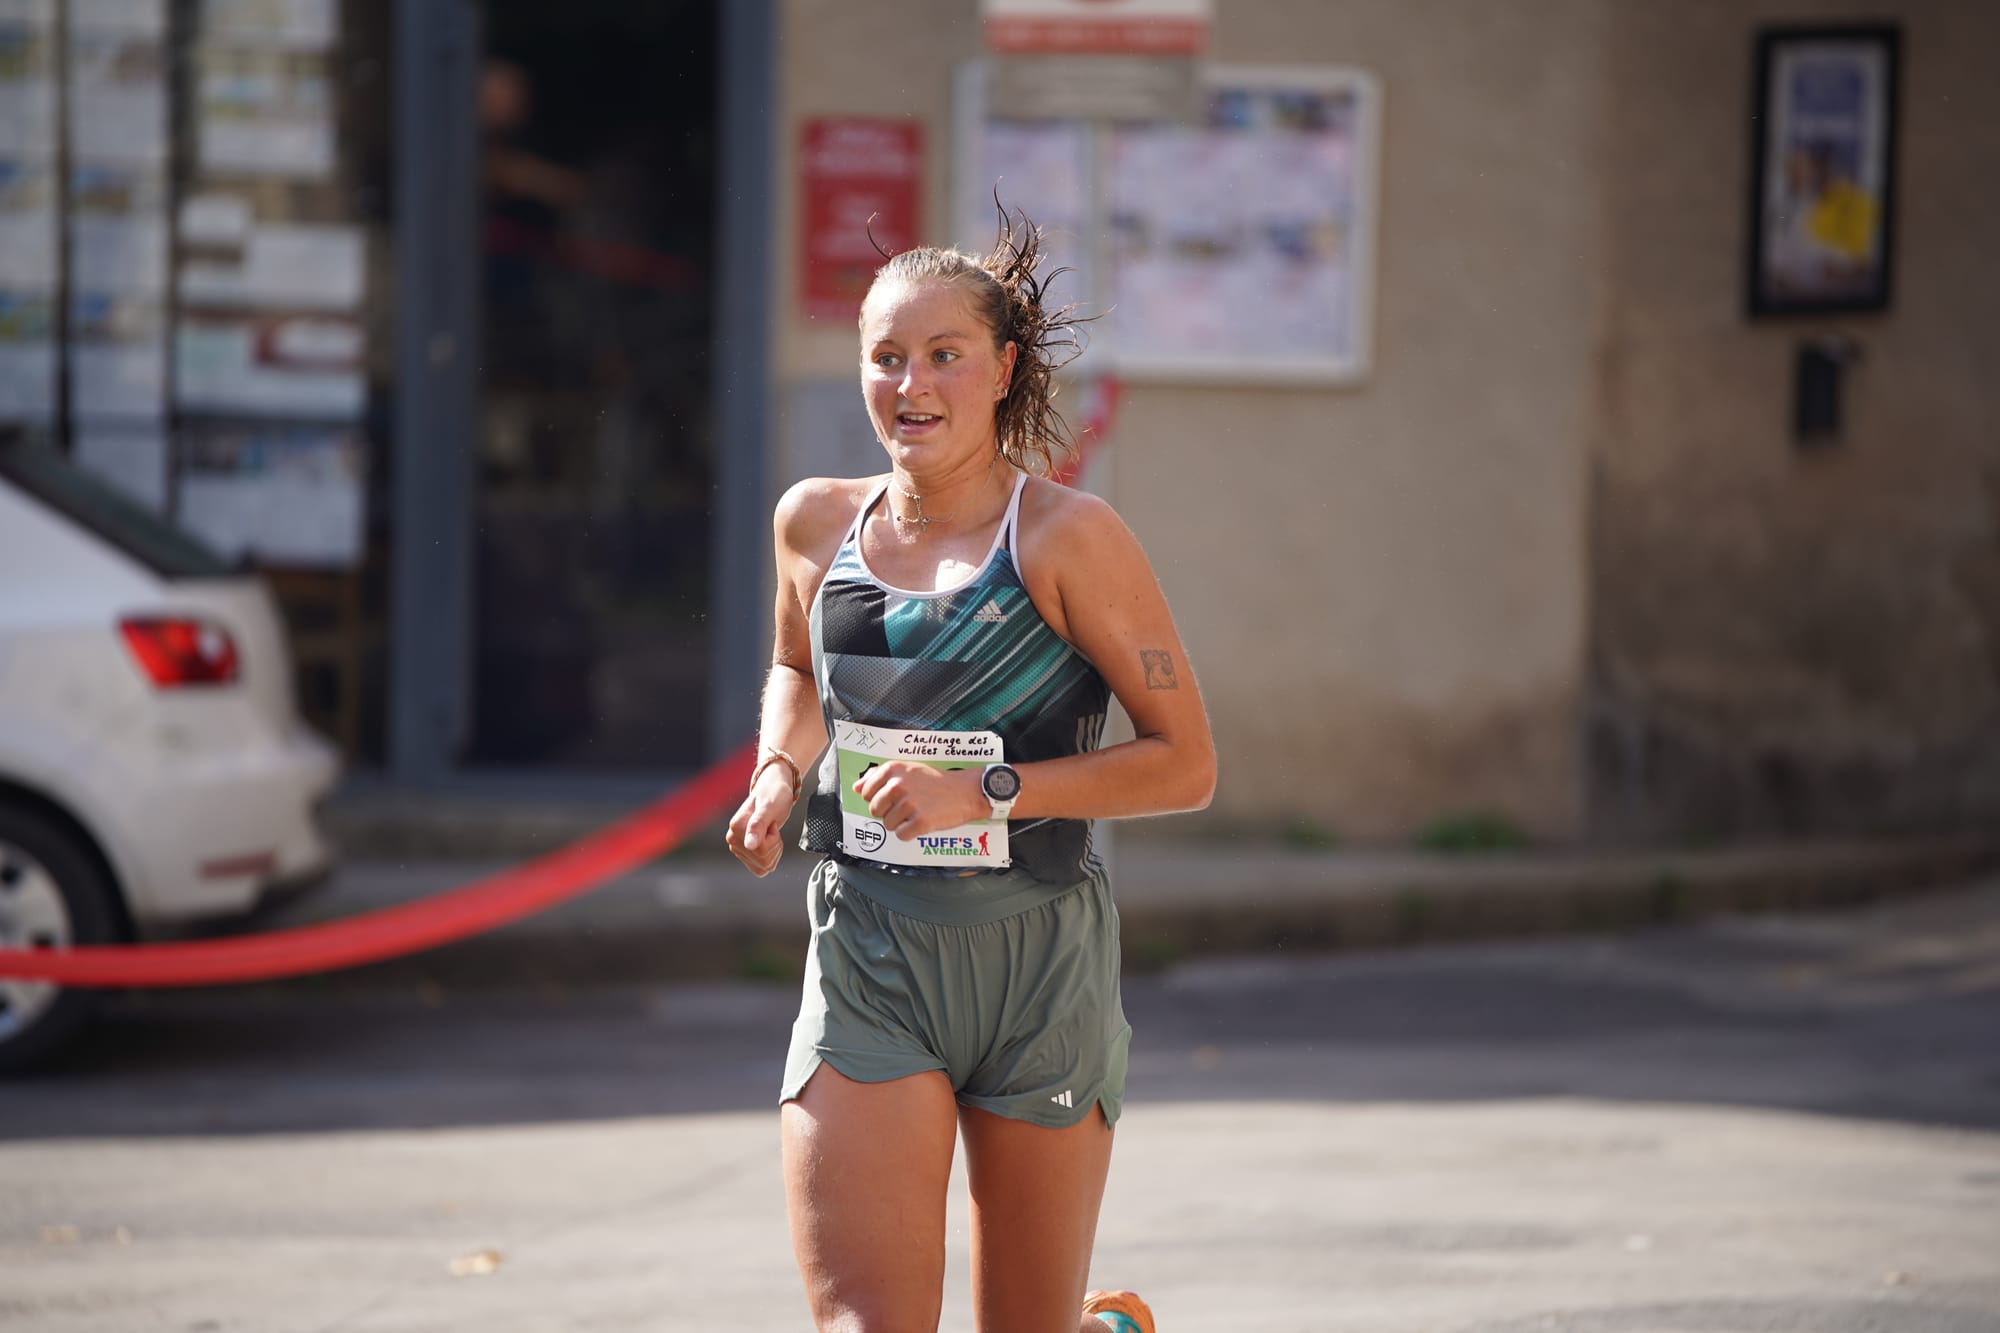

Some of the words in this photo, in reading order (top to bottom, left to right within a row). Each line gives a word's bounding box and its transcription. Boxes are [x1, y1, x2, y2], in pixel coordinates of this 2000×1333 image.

[973, 614, 1008, 623] adidas
[904, 734, 961, 747] Challenge
[968, 736, 988, 745] des
[898, 745, 938, 755] vallées
[944, 746, 995, 756] cévenoles
[855, 828, 882, 843] BFP
[917, 837, 973, 848] TUFF'S
[923, 845, 979, 856] Aventure
